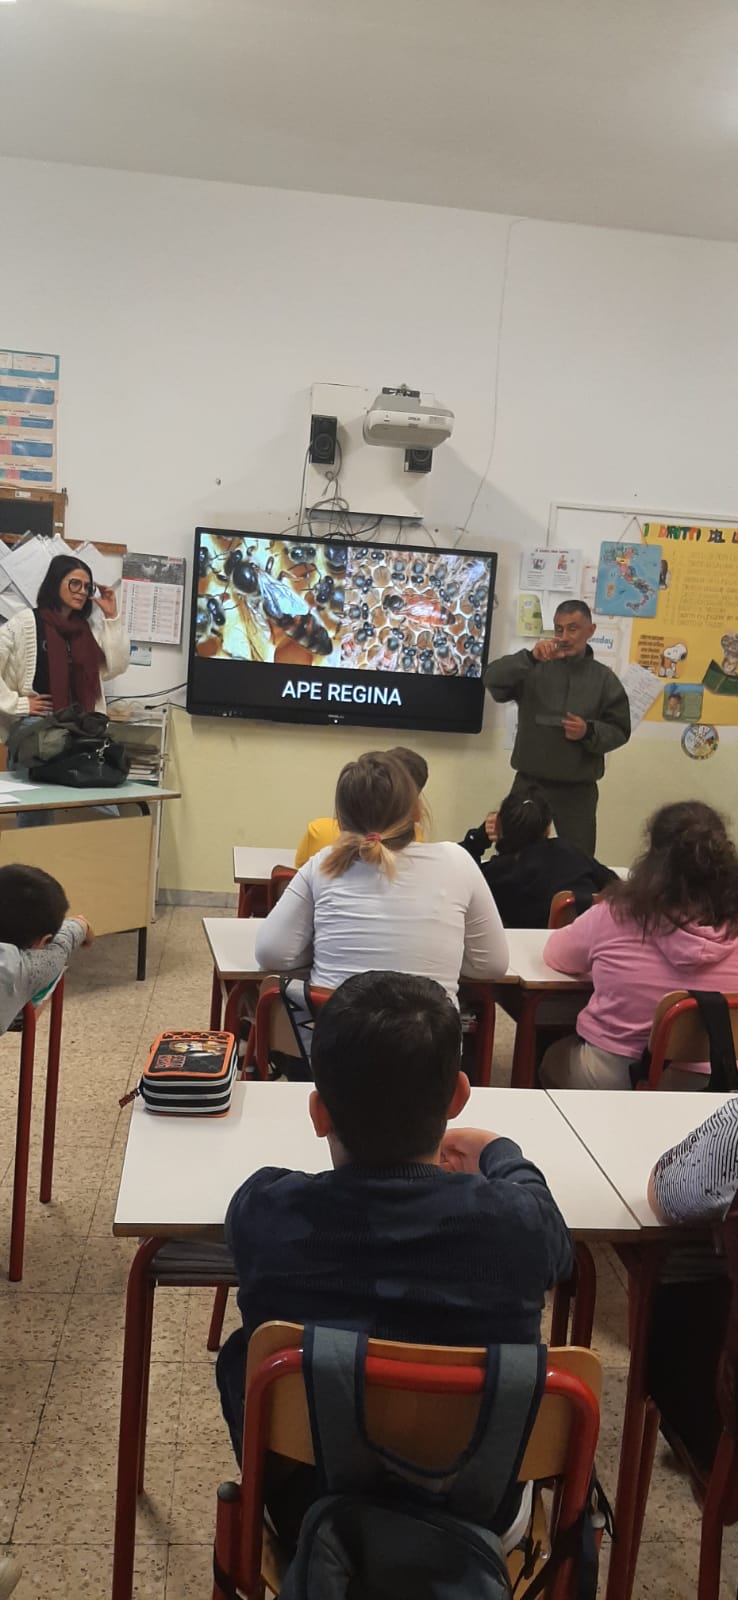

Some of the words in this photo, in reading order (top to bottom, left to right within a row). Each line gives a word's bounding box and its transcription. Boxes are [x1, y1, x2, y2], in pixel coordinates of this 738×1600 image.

[643, 523, 650, 537] I
[588, 634, 614, 649] esday
[281, 680, 322, 700] APE
[327, 683, 402, 706] REGINA
